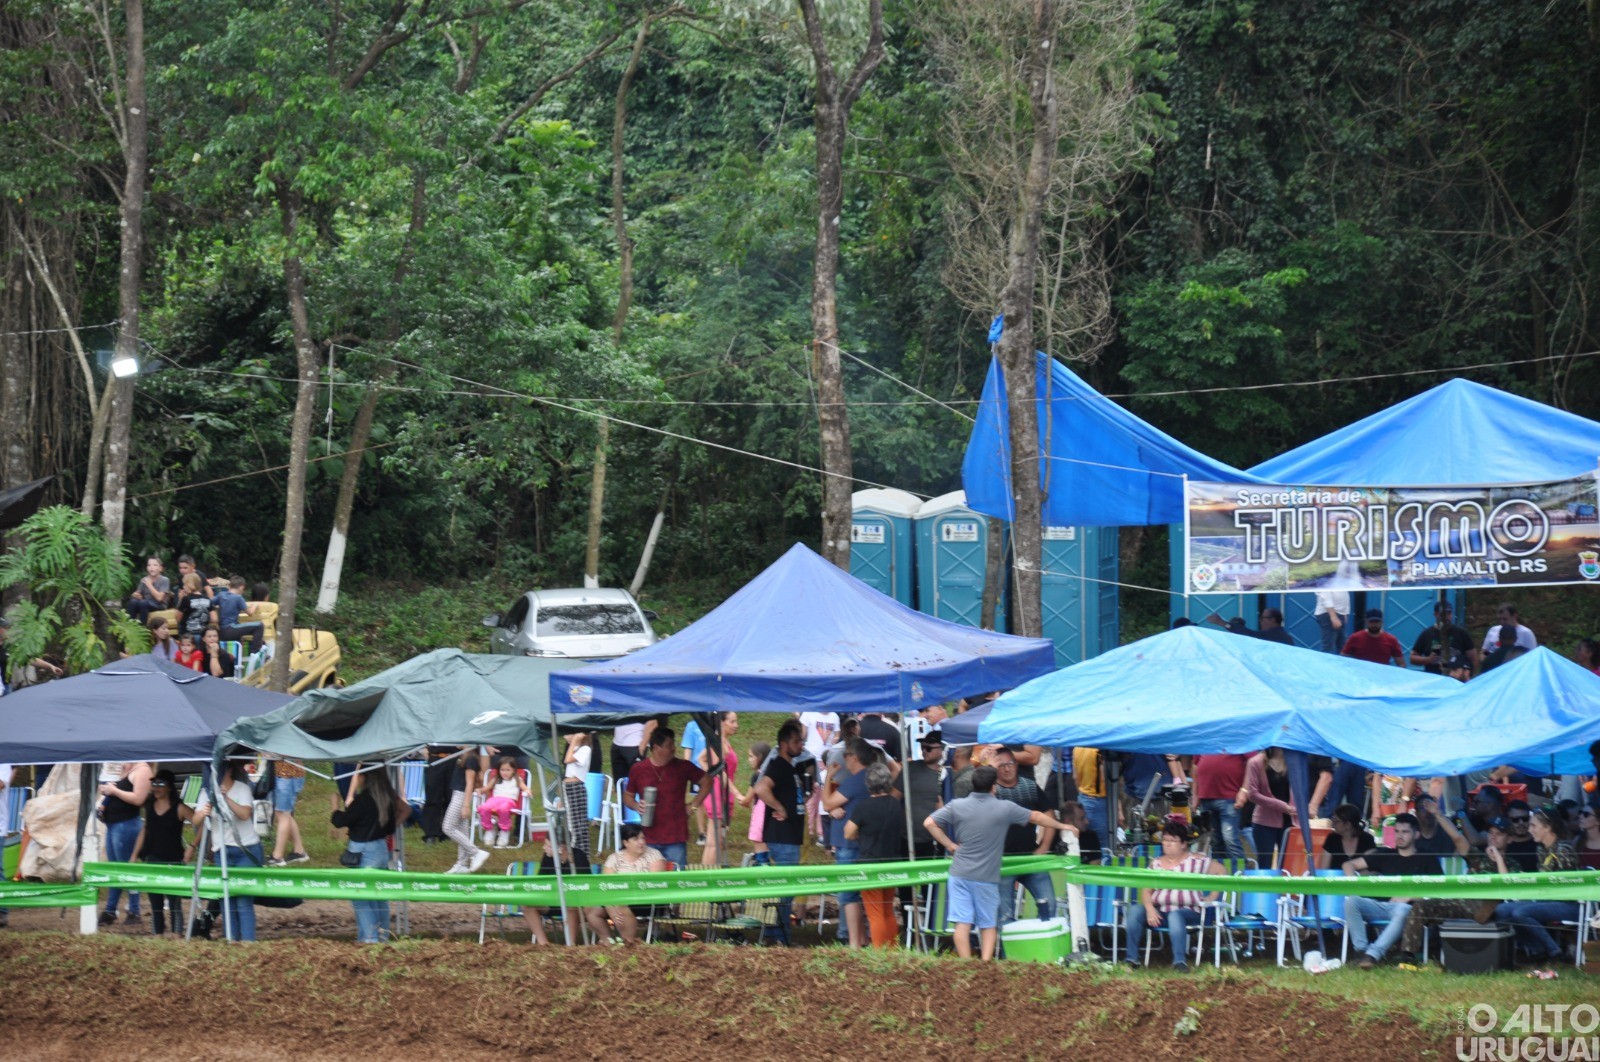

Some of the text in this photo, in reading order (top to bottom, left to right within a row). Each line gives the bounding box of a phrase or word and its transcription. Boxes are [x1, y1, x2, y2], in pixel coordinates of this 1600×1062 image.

[1237, 489, 1362, 506] Secretaria de
[1234, 498, 1549, 564] TURISMO
[1412, 558, 1548, 576] PLANALTO-RS
